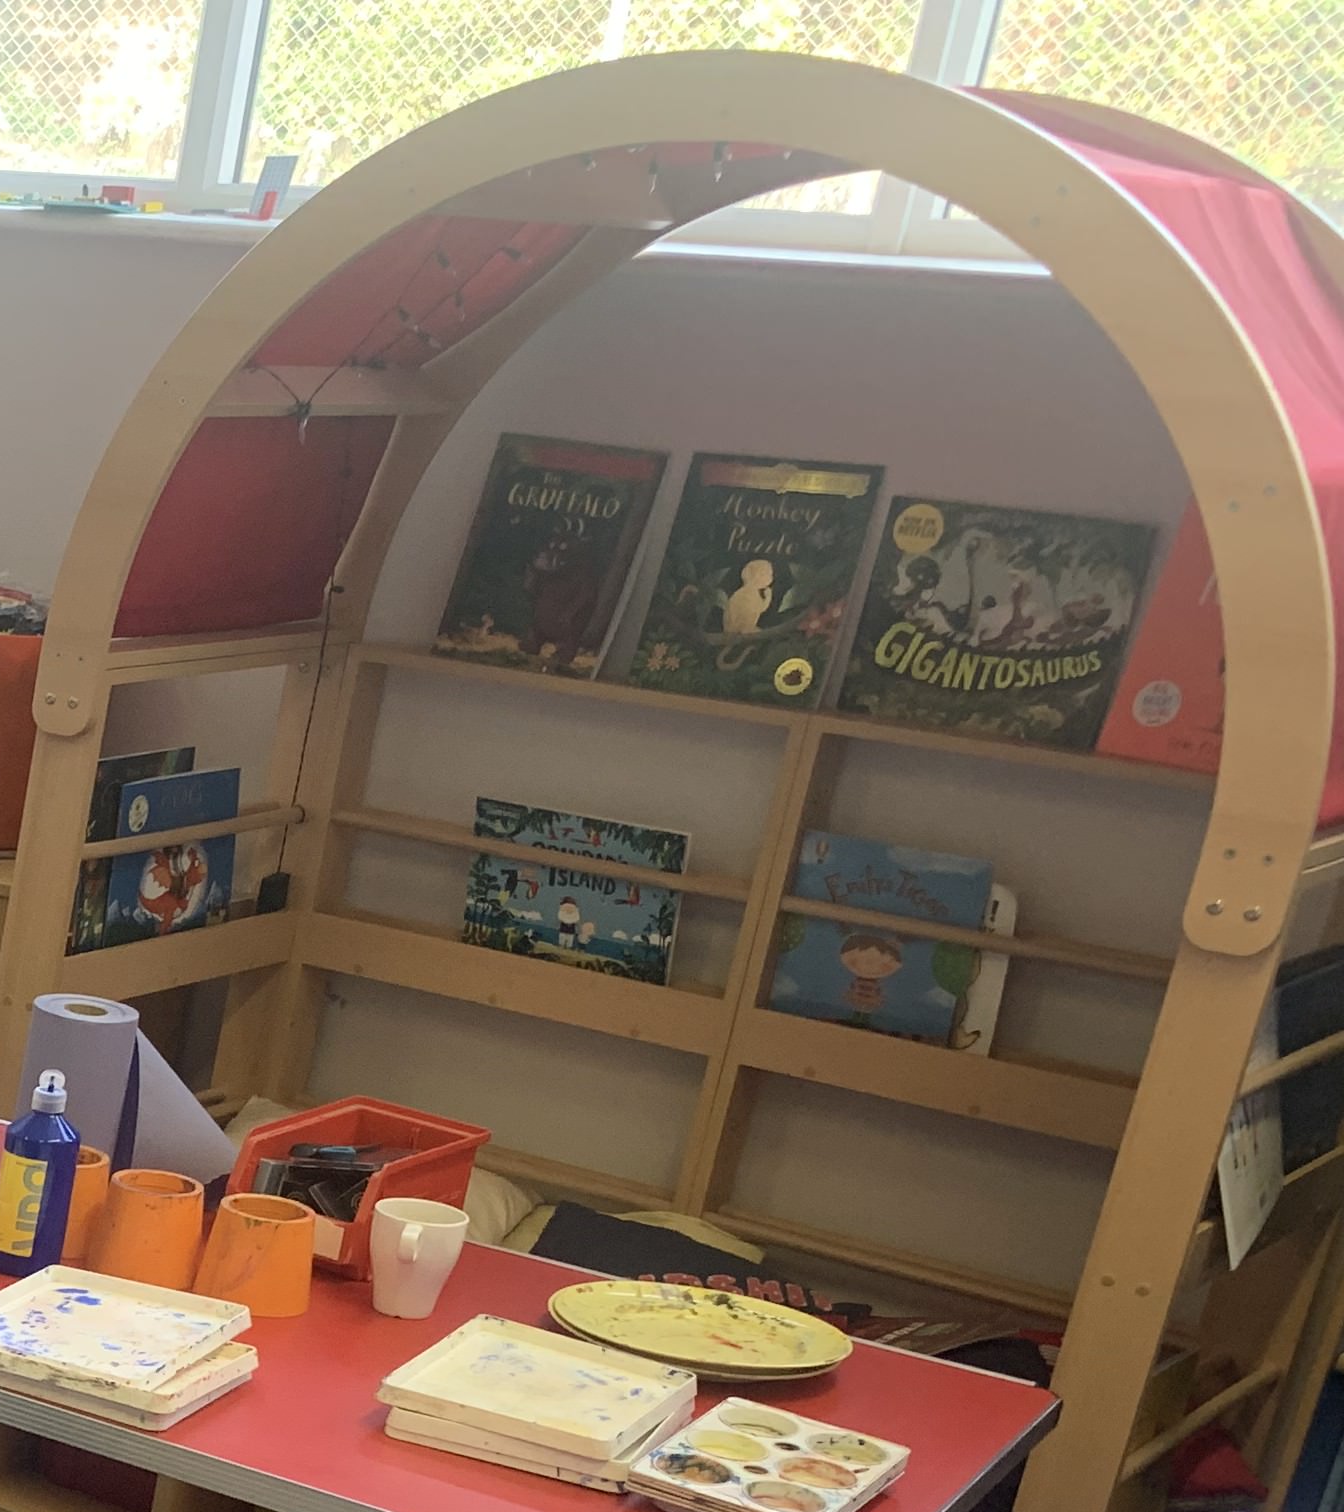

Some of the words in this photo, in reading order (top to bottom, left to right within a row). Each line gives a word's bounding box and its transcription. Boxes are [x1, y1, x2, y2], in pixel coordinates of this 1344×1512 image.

[507, 482, 621, 519] GRUFFALO
[719, 494, 822, 530] Monkey
[727, 522, 799, 555] Puzzle
[874, 621, 1102, 691] GIGANTOSAURUS
[548, 866, 617, 896] ISLAND
